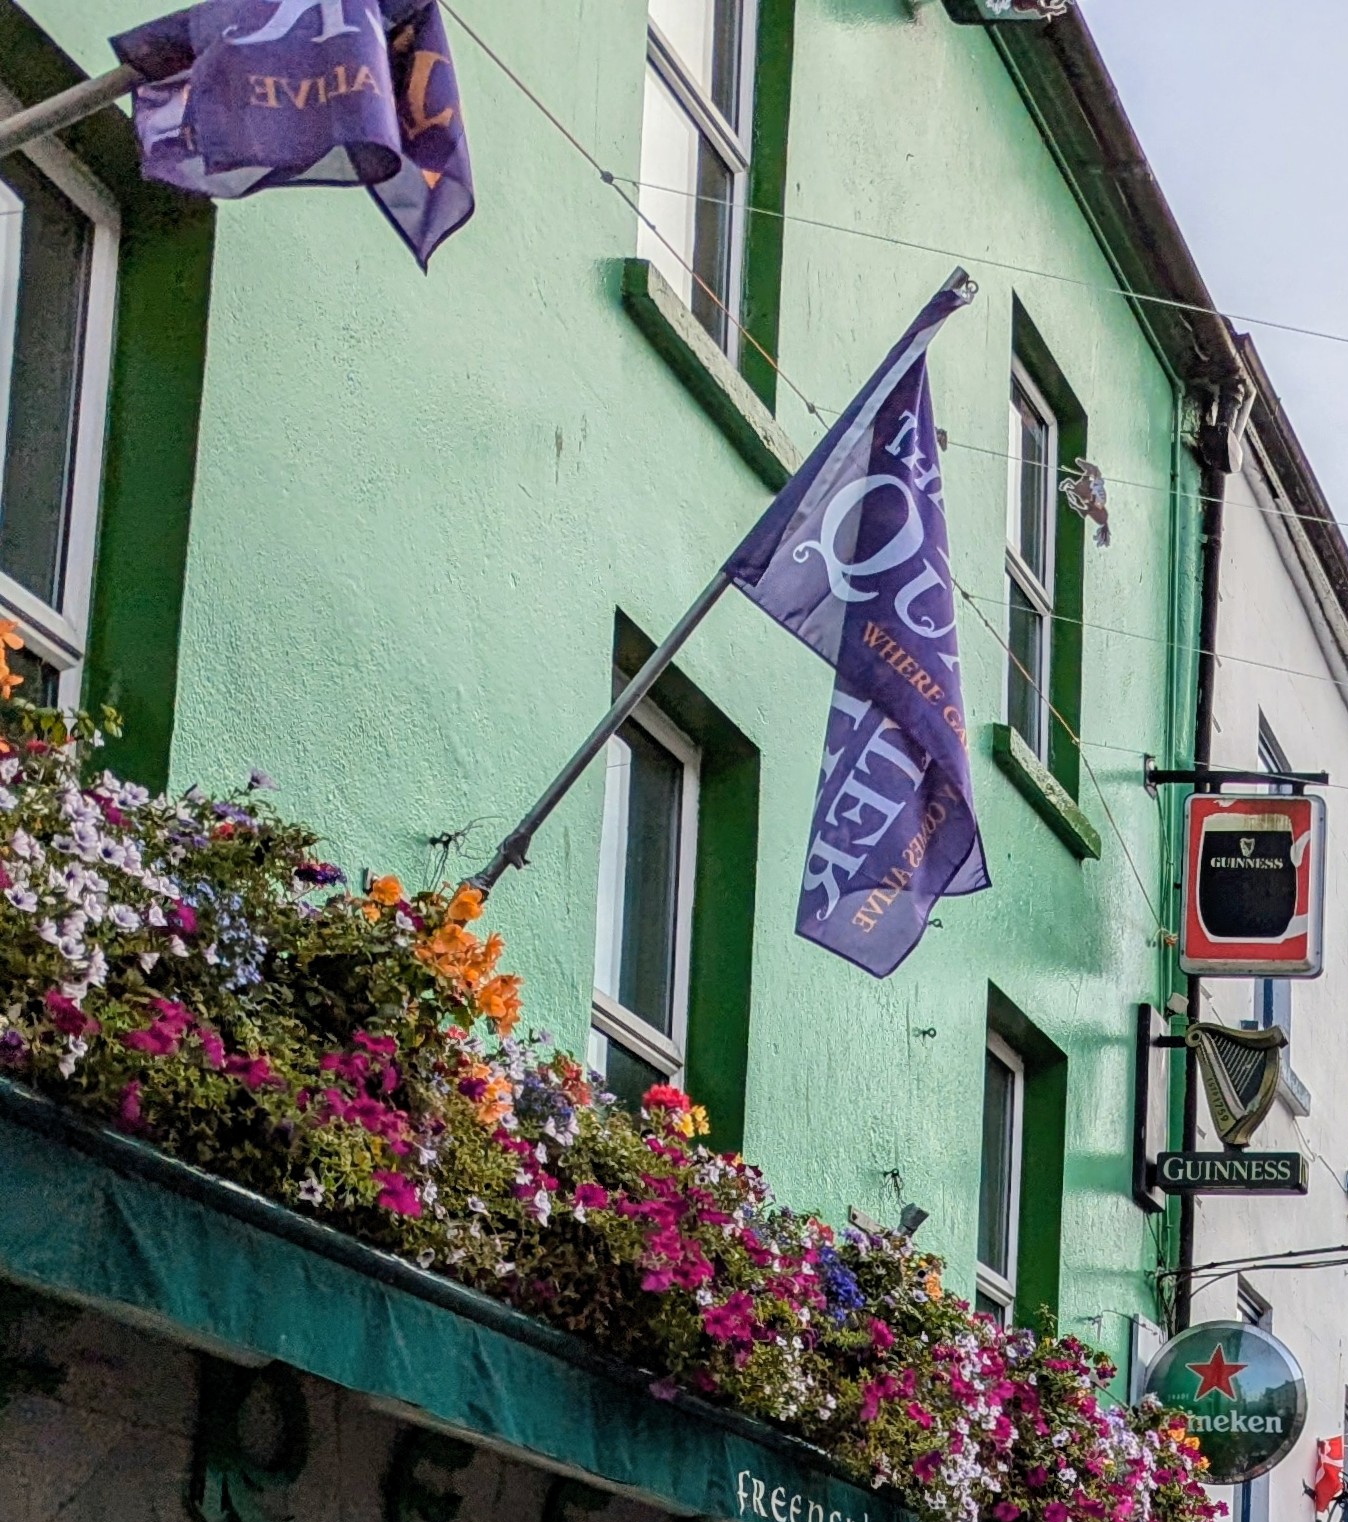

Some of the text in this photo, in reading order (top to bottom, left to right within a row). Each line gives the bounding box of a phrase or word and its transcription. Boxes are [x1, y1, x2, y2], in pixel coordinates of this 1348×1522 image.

[863, 622, 945, 709] WHERE
[1210, 856, 1284, 870] GUINNESS
[1163, 1157, 1291, 1181] GUINNESS
[1187, 1409, 1283, 1434] ineken
